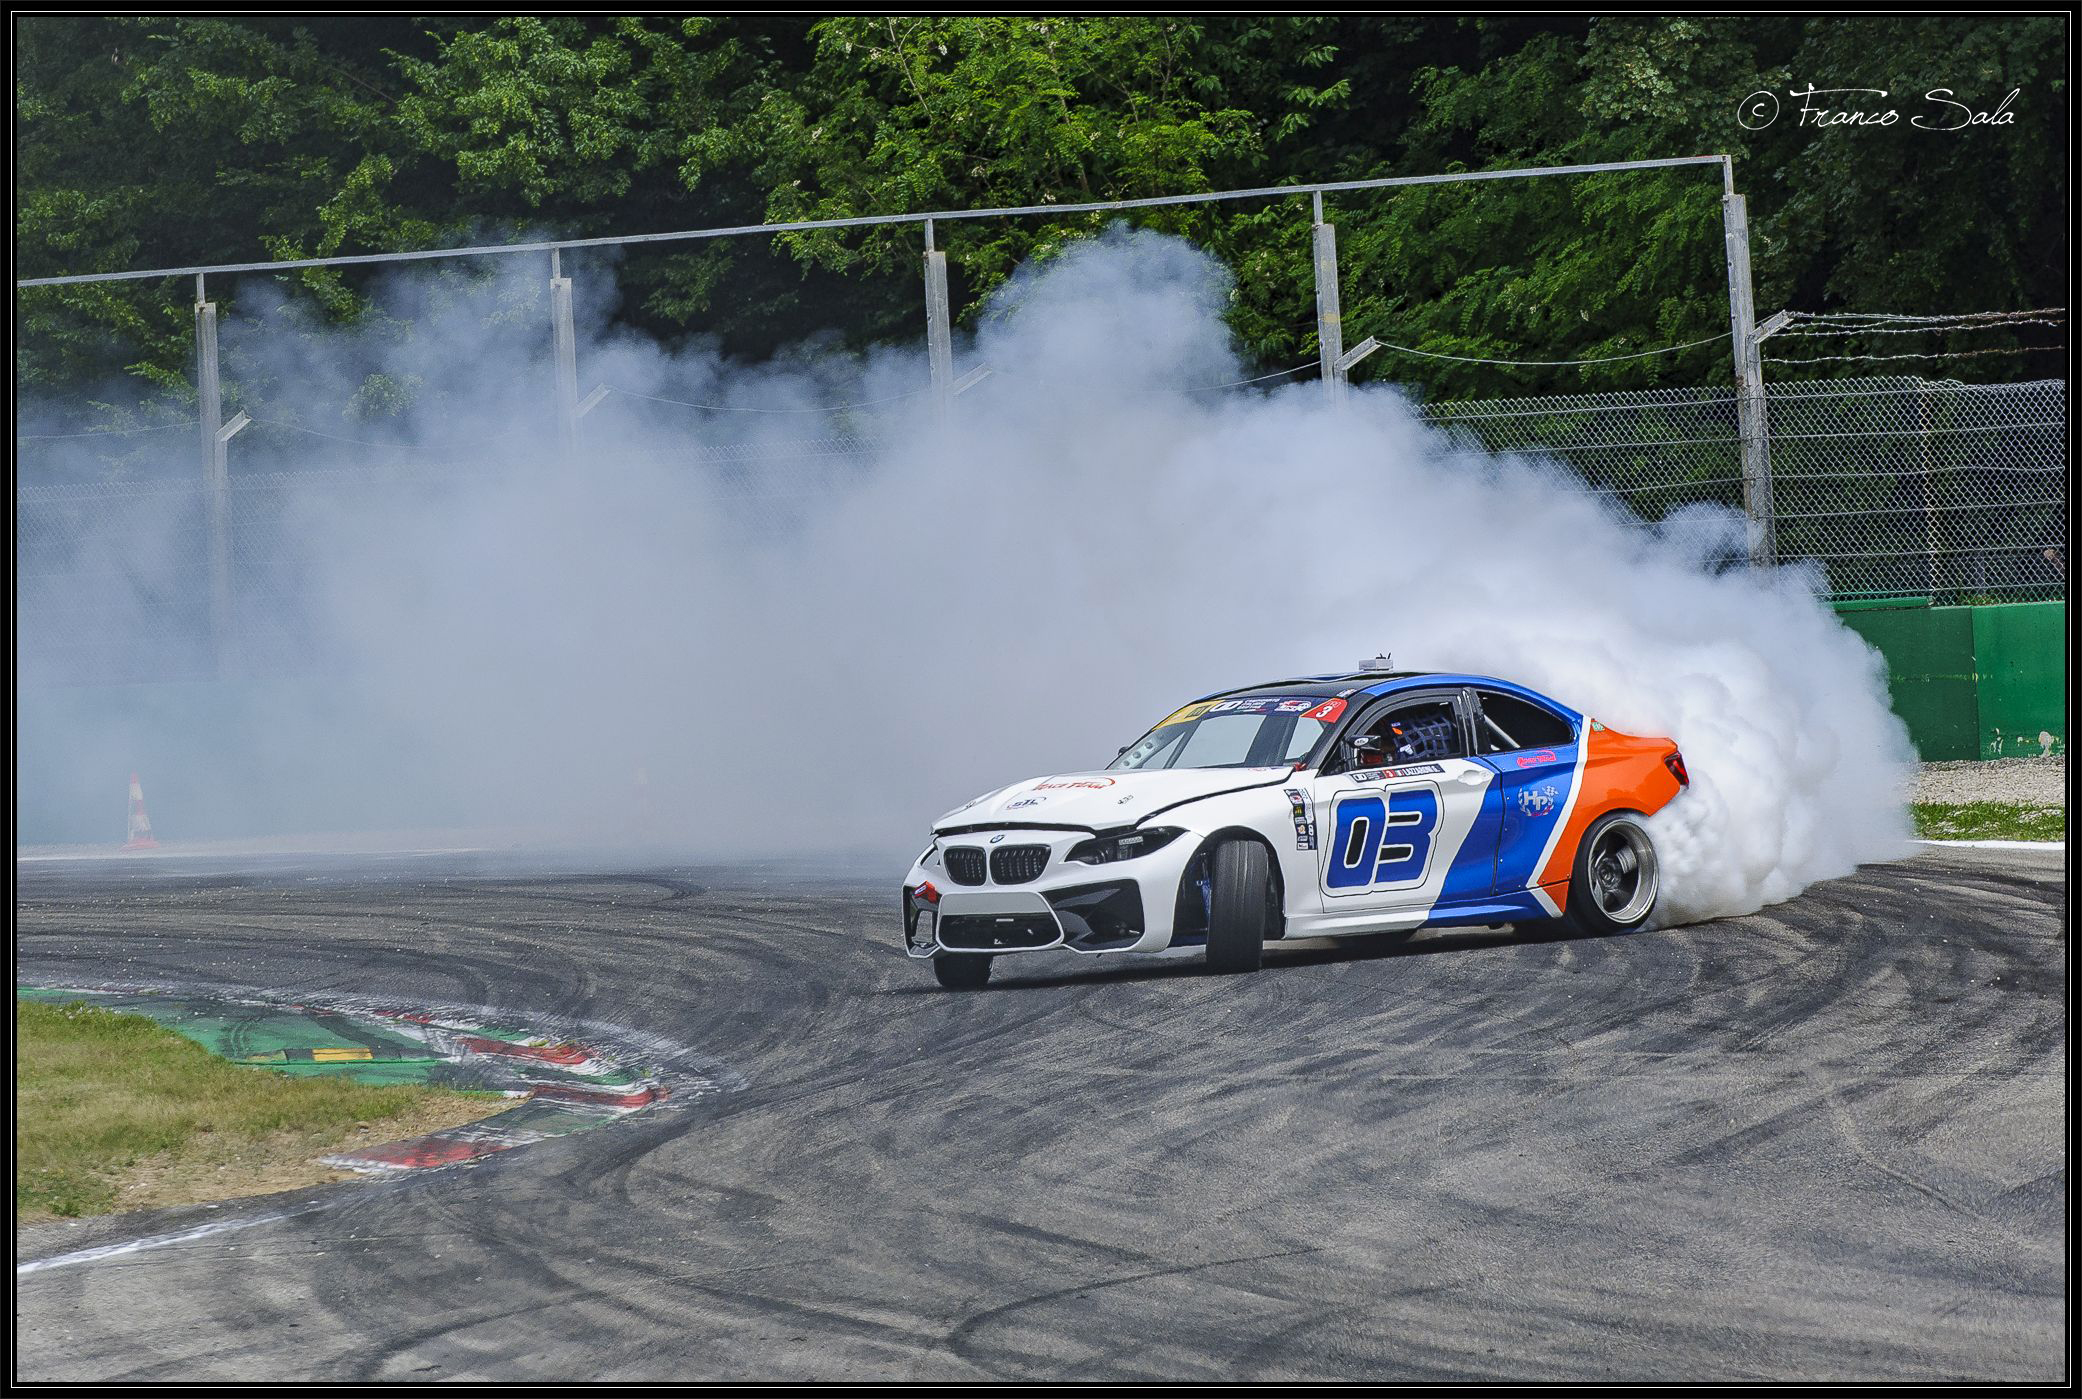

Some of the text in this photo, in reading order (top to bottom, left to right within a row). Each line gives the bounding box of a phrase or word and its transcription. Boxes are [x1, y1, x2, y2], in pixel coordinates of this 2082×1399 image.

[1315, 705, 1334, 718] 3
[1523, 790, 1548, 811] HP
[1325, 787, 1440, 890] 03
